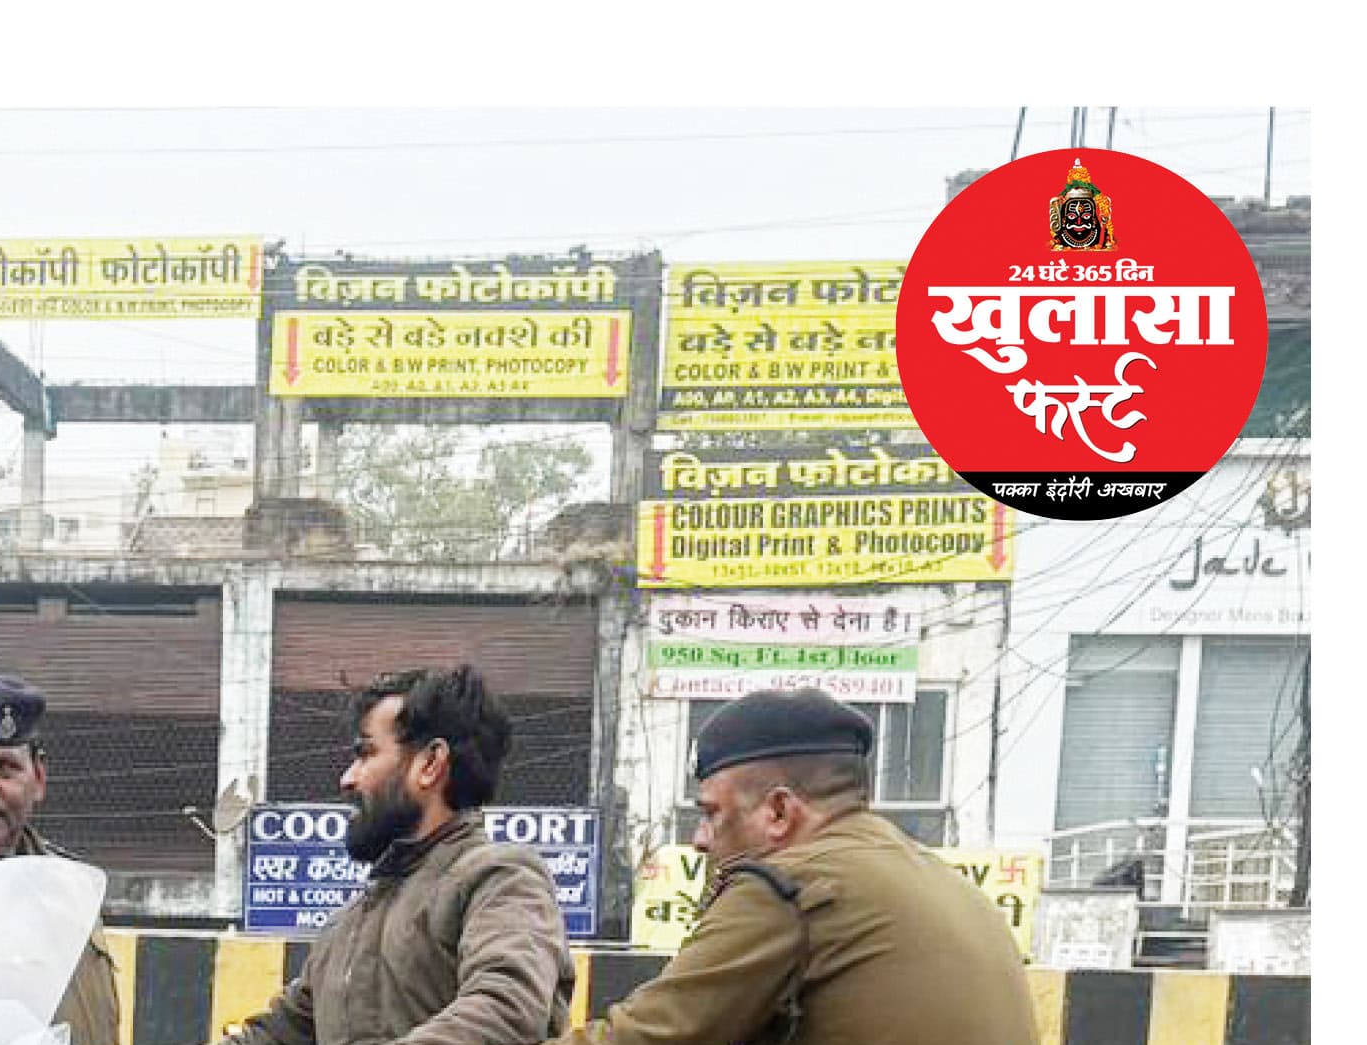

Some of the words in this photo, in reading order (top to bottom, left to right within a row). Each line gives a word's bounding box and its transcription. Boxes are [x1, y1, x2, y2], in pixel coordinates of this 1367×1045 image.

[100, 243, 242, 286] फोटोकॉपी
[417, 264, 617, 303] फोटोकॉपी
[364, 317, 394, 348] से
[549, 316, 592, 348] की
[743, 321, 777, 352] से
[312, 358, 369, 374] COLOR
[375, 358, 386, 374] &
[486, 358, 588, 373] PHOTOCOPY
[675, 363, 740, 382] COLOR
[748, 363, 760, 379] &
[810, 361, 870, 380] PRINT
[672, 503, 765, 531] COLOUR
[770, 501, 893, 529] GRAPHICS
[899, 497, 986, 526] PRINTS
[672, 533, 750, 562] Digital
[759, 532, 815, 557] Print
[826, 534, 843, 556] &
[855, 529, 986, 557] Photocopy
[657, 609, 718, 634] दुकान
[729, 603, 791, 632] किराए
[800, 604, 823, 630] से
[832, 604, 871, 632] देना
[661, 647, 704, 665] 950
[710, 647, 748, 668] Sq.
[253, 810, 349, 841] COO
[483, 812, 592, 844] FORT
[252, 887, 284, 904] HOT
[287, 888, 301, 904] &
[303, 887, 344, 905] COOL
